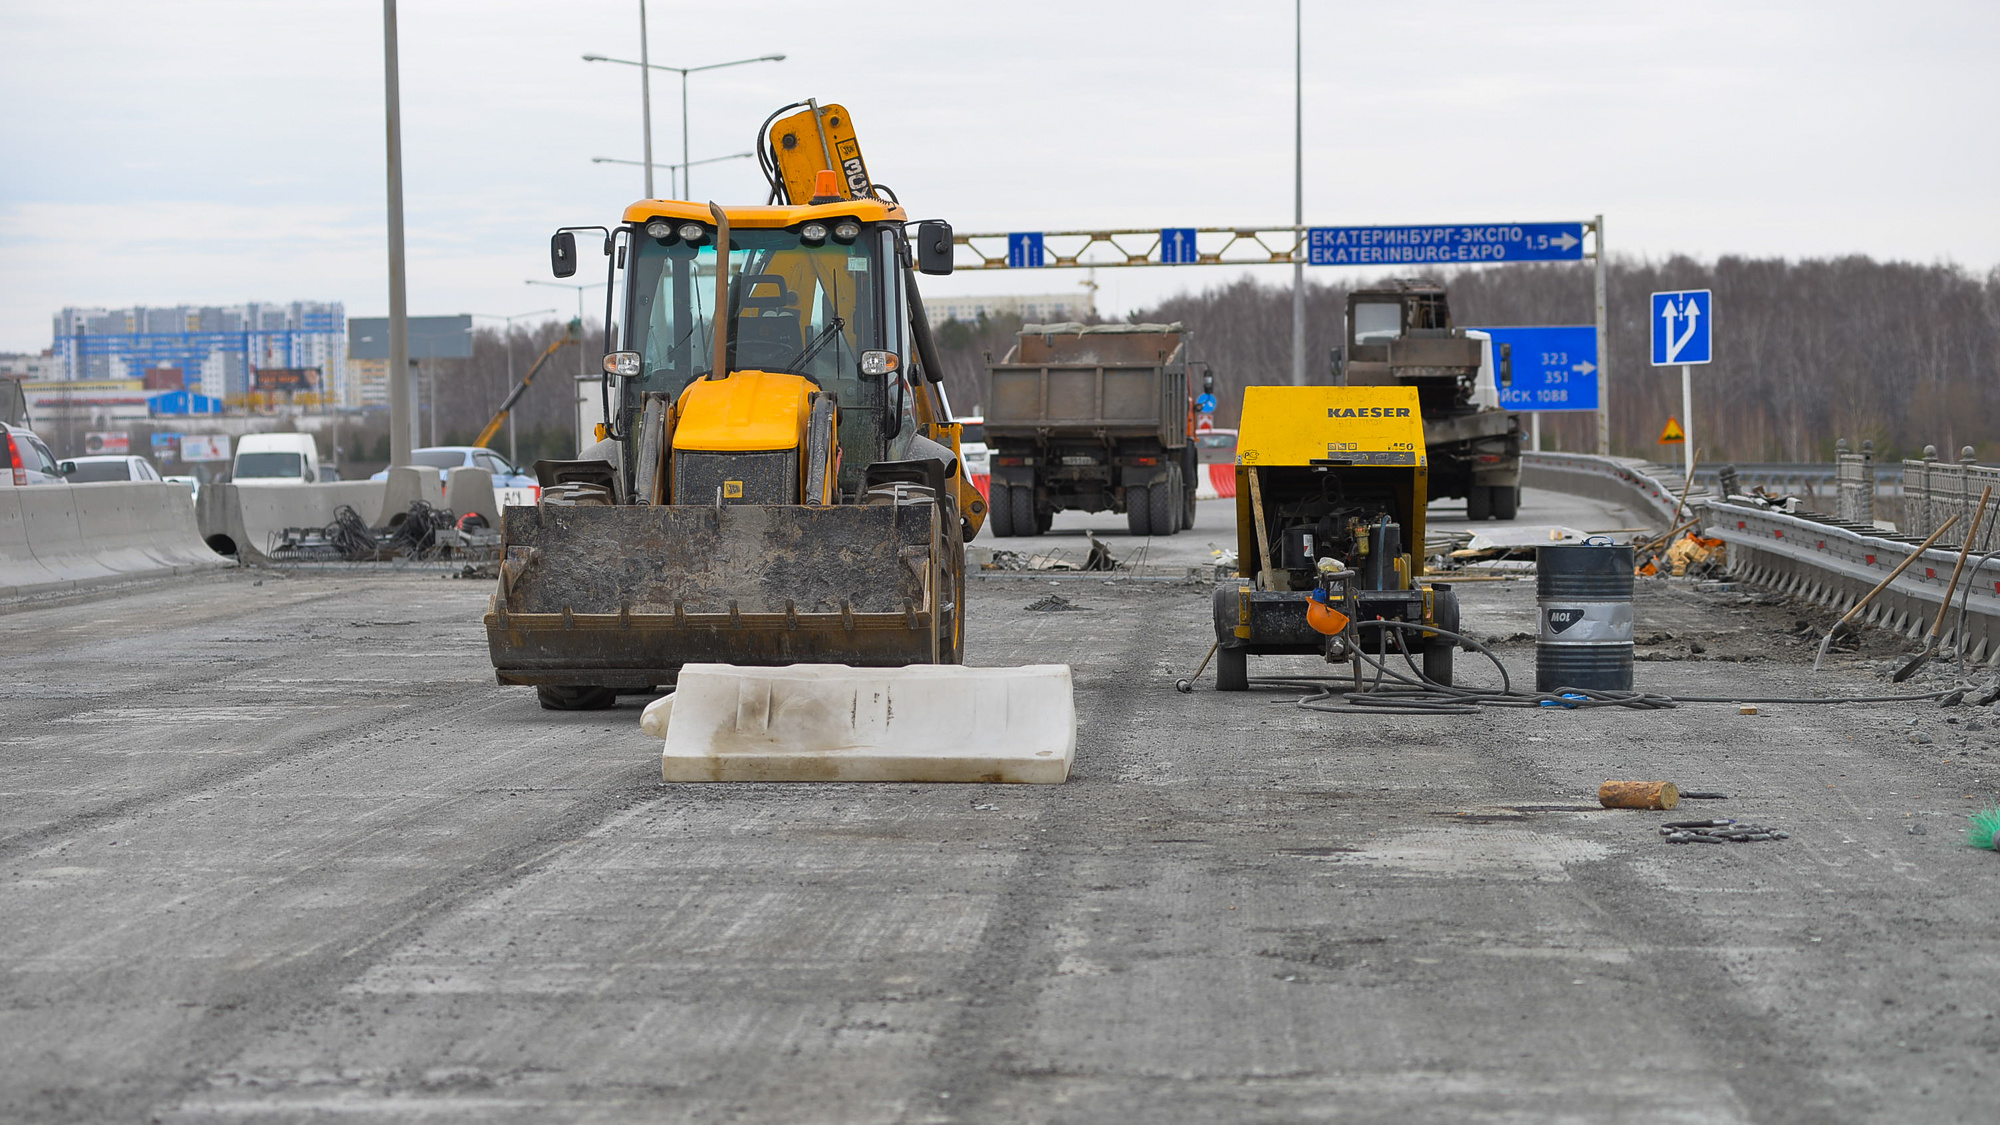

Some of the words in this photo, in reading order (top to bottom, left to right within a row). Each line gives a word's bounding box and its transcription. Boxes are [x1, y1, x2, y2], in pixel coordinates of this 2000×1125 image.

[1311, 226, 1523, 246] ЕКАТЕРИНБУРГ-ЭКСПО
[1311, 244, 1506, 263] EKATERINBURG-EXPO
[1541, 352, 1568, 366] 323
[1544, 371, 1569, 384] 351
[1536, 389, 1568, 402] 1088
[1327, 407, 1410, 418] KAESER
[1550, 612, 1571, 622] MOL
